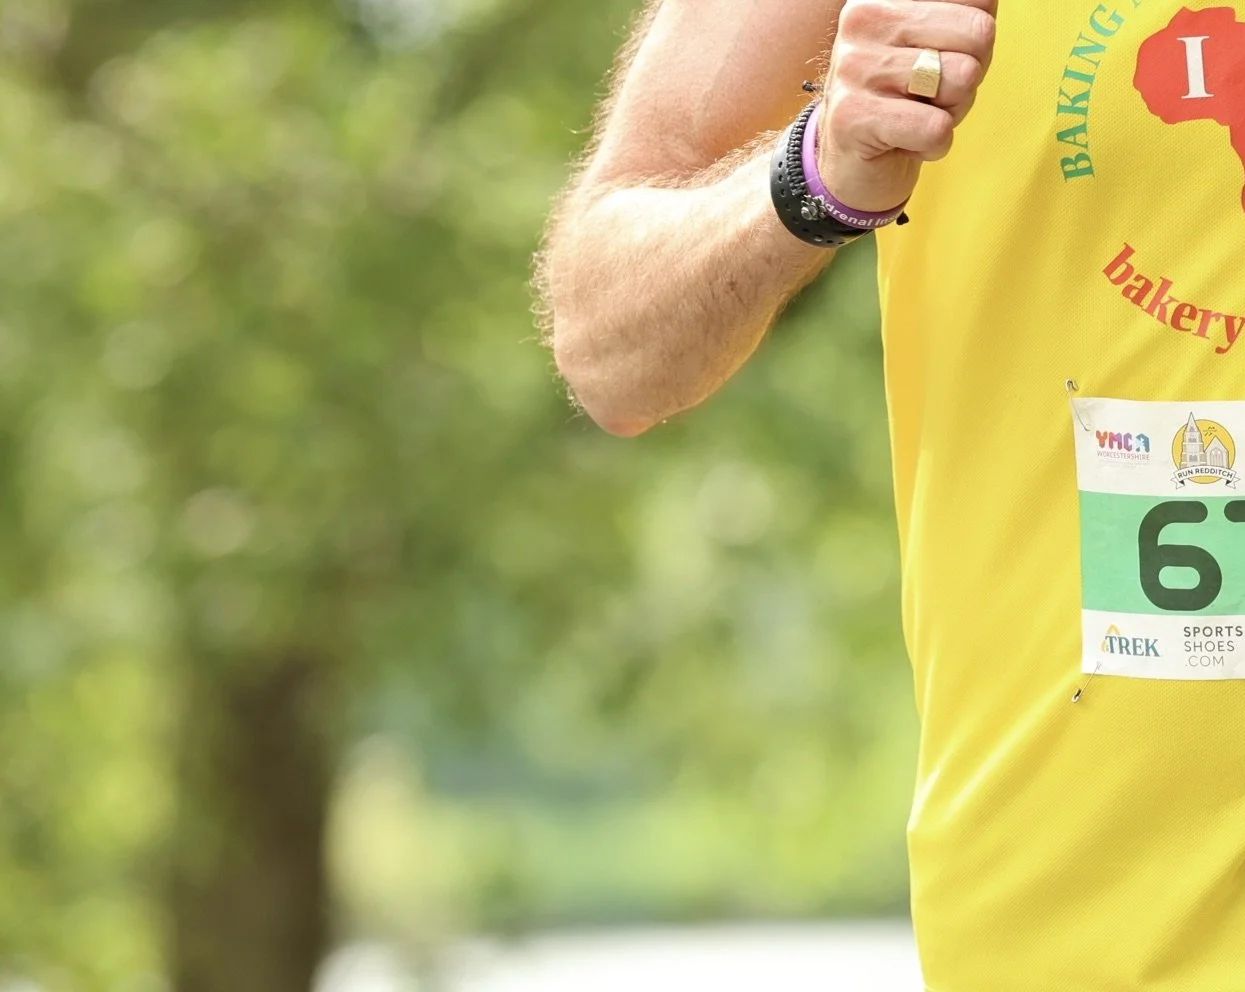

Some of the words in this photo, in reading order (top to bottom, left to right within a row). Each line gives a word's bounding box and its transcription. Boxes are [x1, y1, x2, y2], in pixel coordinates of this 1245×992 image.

[1176, 35, 1215, 100] I
[1056, 3, 1125, 183] BAKING
[812, 194, 873, 227] Adrenal
[1095, 430, 1151, 453] YMCA
[1096, 450, 1151, 461] WORCESTERSHIRE
[1177, 467, 1194, 479] RUN
[1194, 467, 1234, 479] REDDITCH
[1183, 625, 1244, 638] SPORTS
[1104, 635, 1161, 658] TREK
[1184, 640, 1236, 653] SHOES
[1185, 655, 1225, 668] .COM
